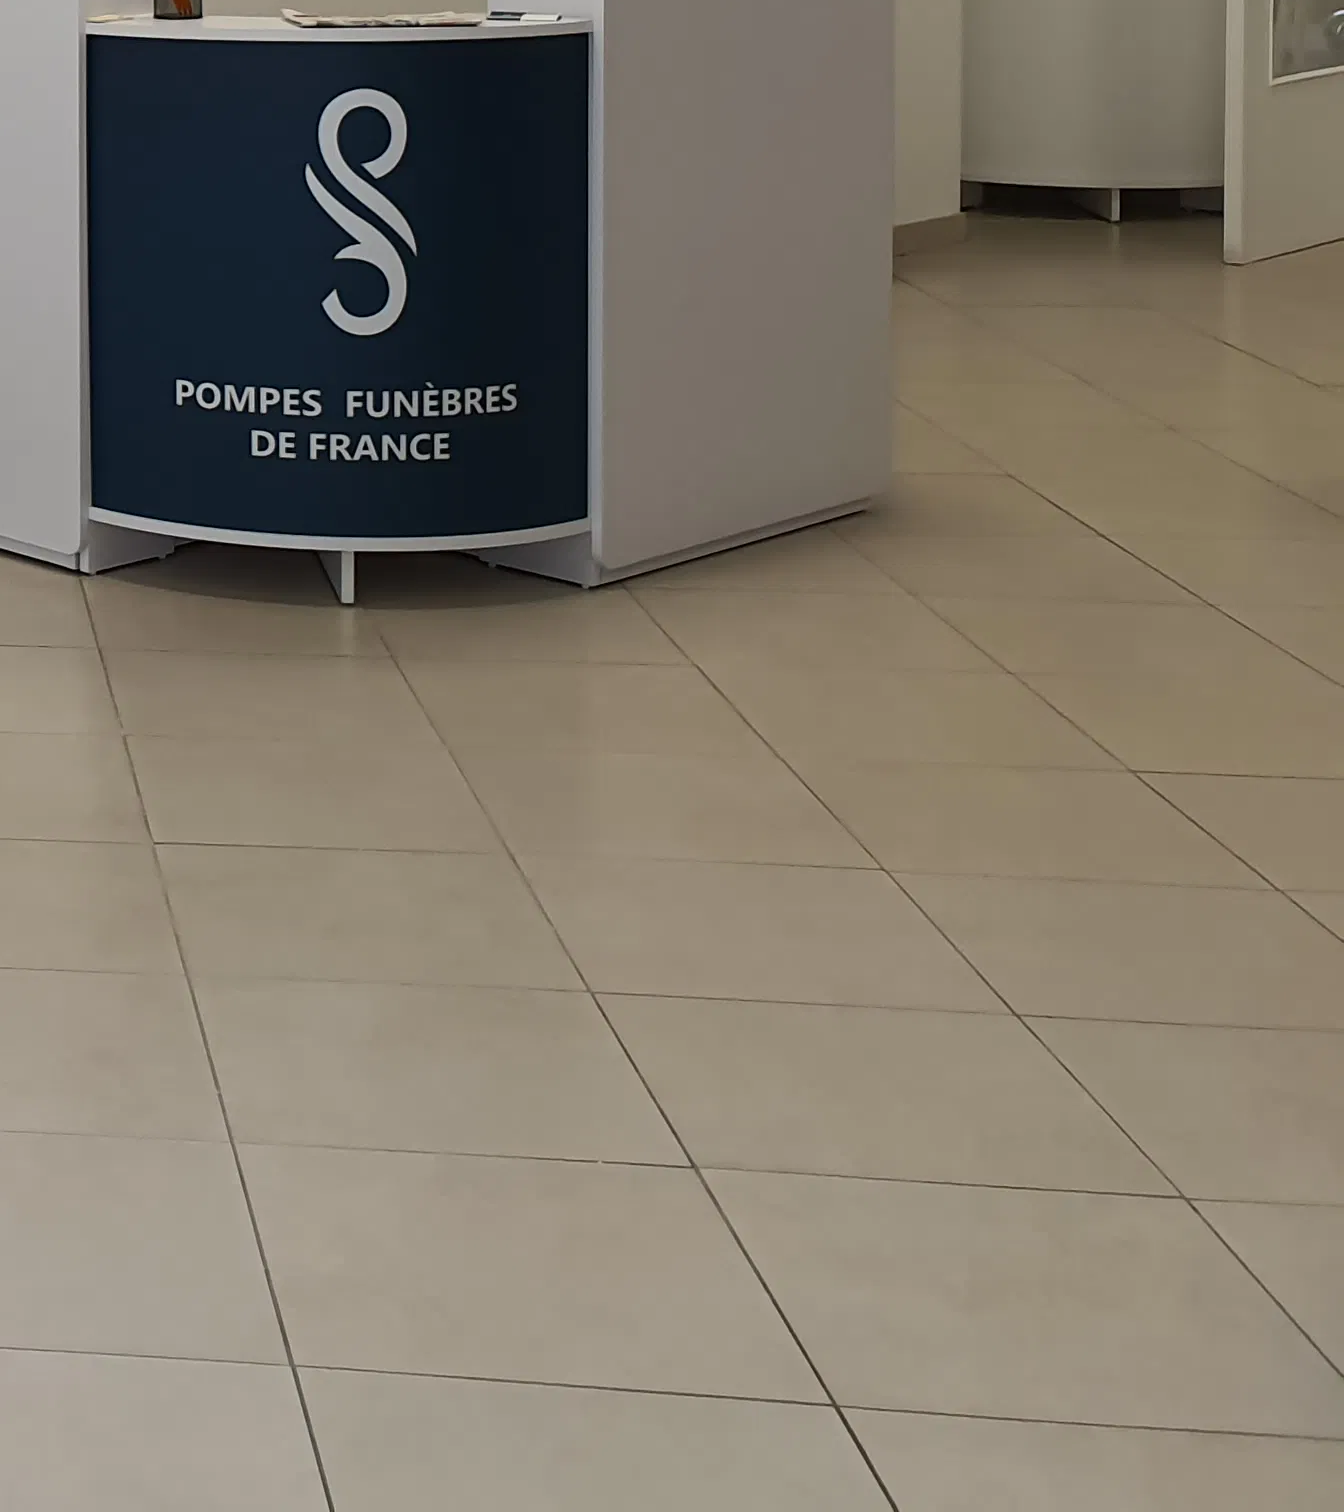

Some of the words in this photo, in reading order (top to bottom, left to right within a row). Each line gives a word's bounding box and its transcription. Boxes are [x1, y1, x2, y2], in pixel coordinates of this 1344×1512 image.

[175, 379, 322, 417] POMPES
[346, 381, 518, 418] FUNÈBRES
[250, 429, 297, 459] DE
[309, 432, 451, 461] FRANCE
